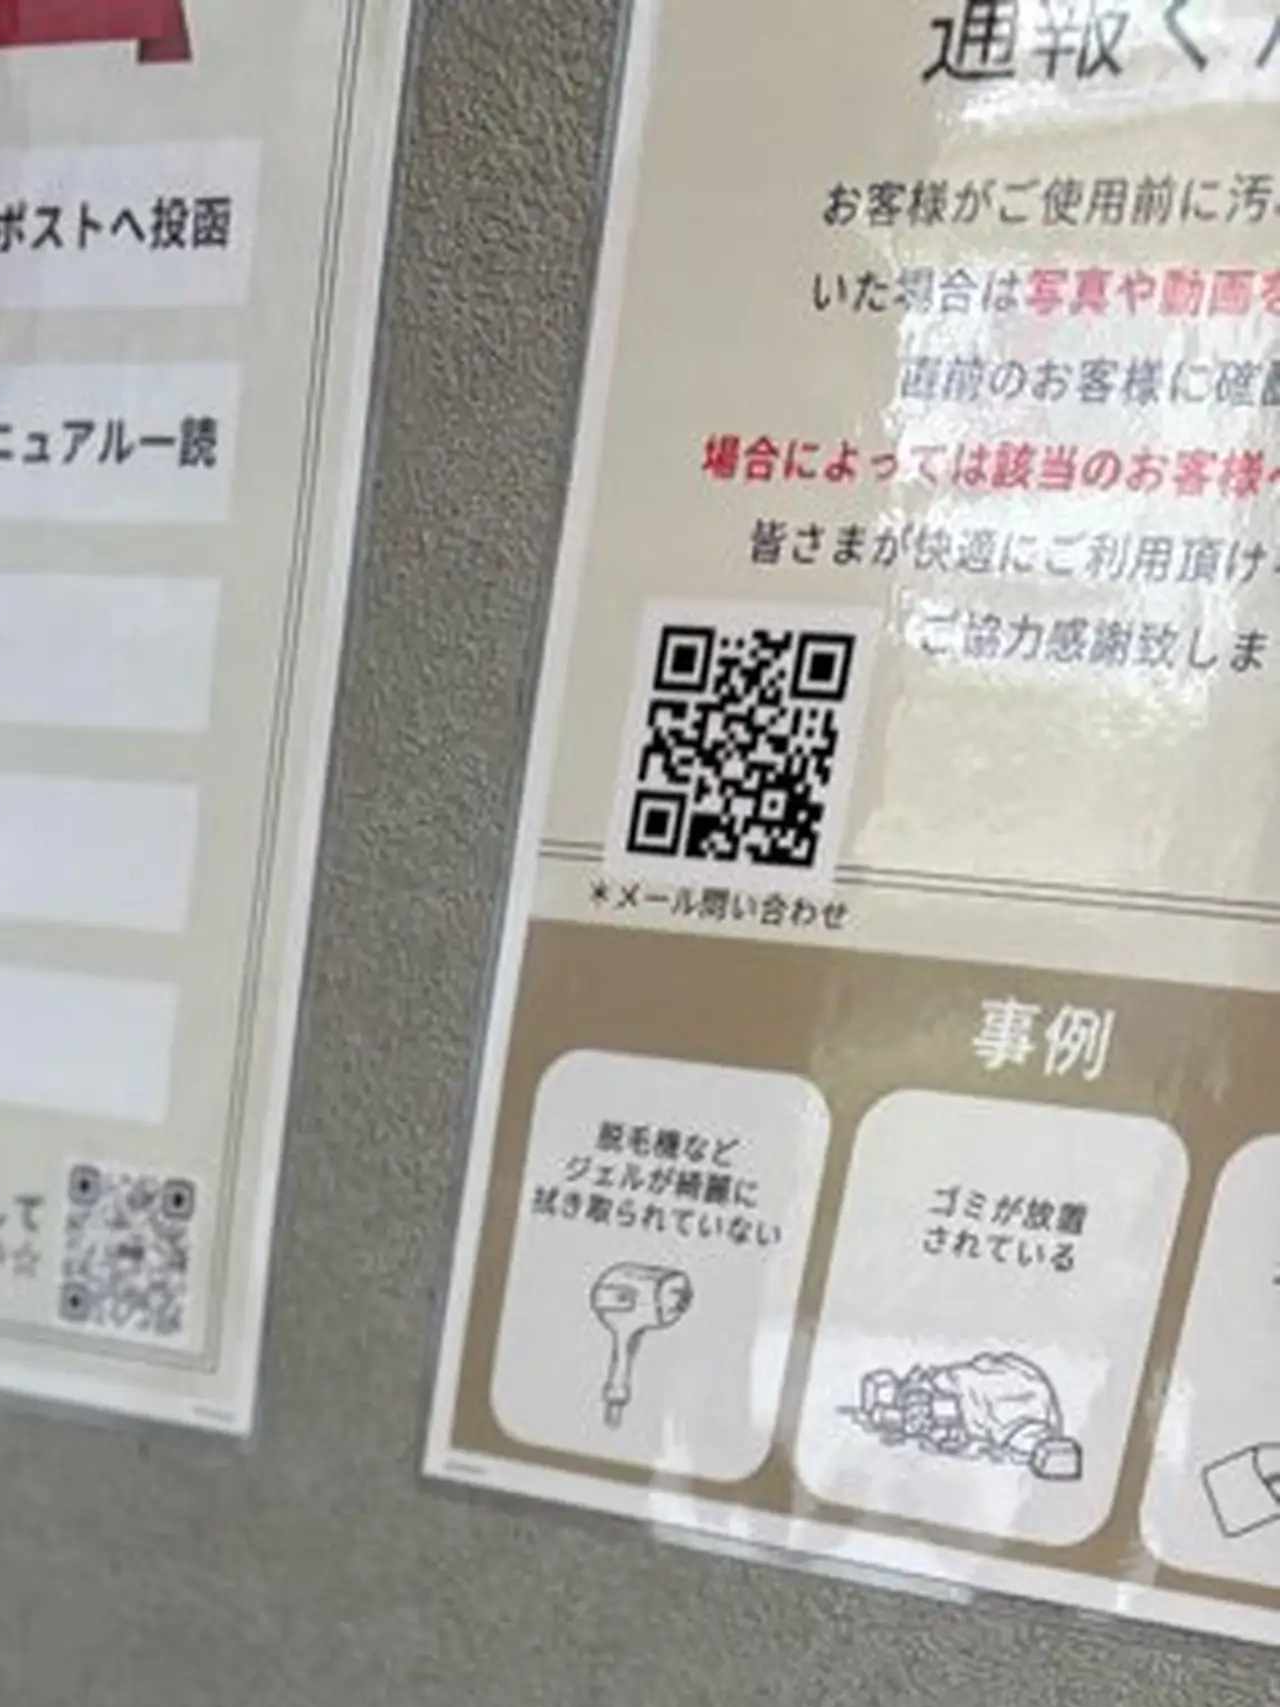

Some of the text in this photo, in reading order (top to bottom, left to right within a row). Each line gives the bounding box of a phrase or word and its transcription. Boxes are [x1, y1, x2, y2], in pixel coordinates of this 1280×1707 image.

[922, 0, 1280, 82] 通報く
[823, 172, 1280, 227] お客様がご使用前に汚
[750, 518, 1280, 585] 皆さまが快適にご利用頂け
[972, 997, 1115, 1081] 事例
[596, 1121, 739, 1168] 脱毛機など
[566, 1154, 759, 1211] ジェルが綺麗に
[926, 1185, 1088, 1237] ゴミが放置
[532, 1186, 782, 1248] 拭き取られていない
[921, 1226, 1077, 1273] されている
